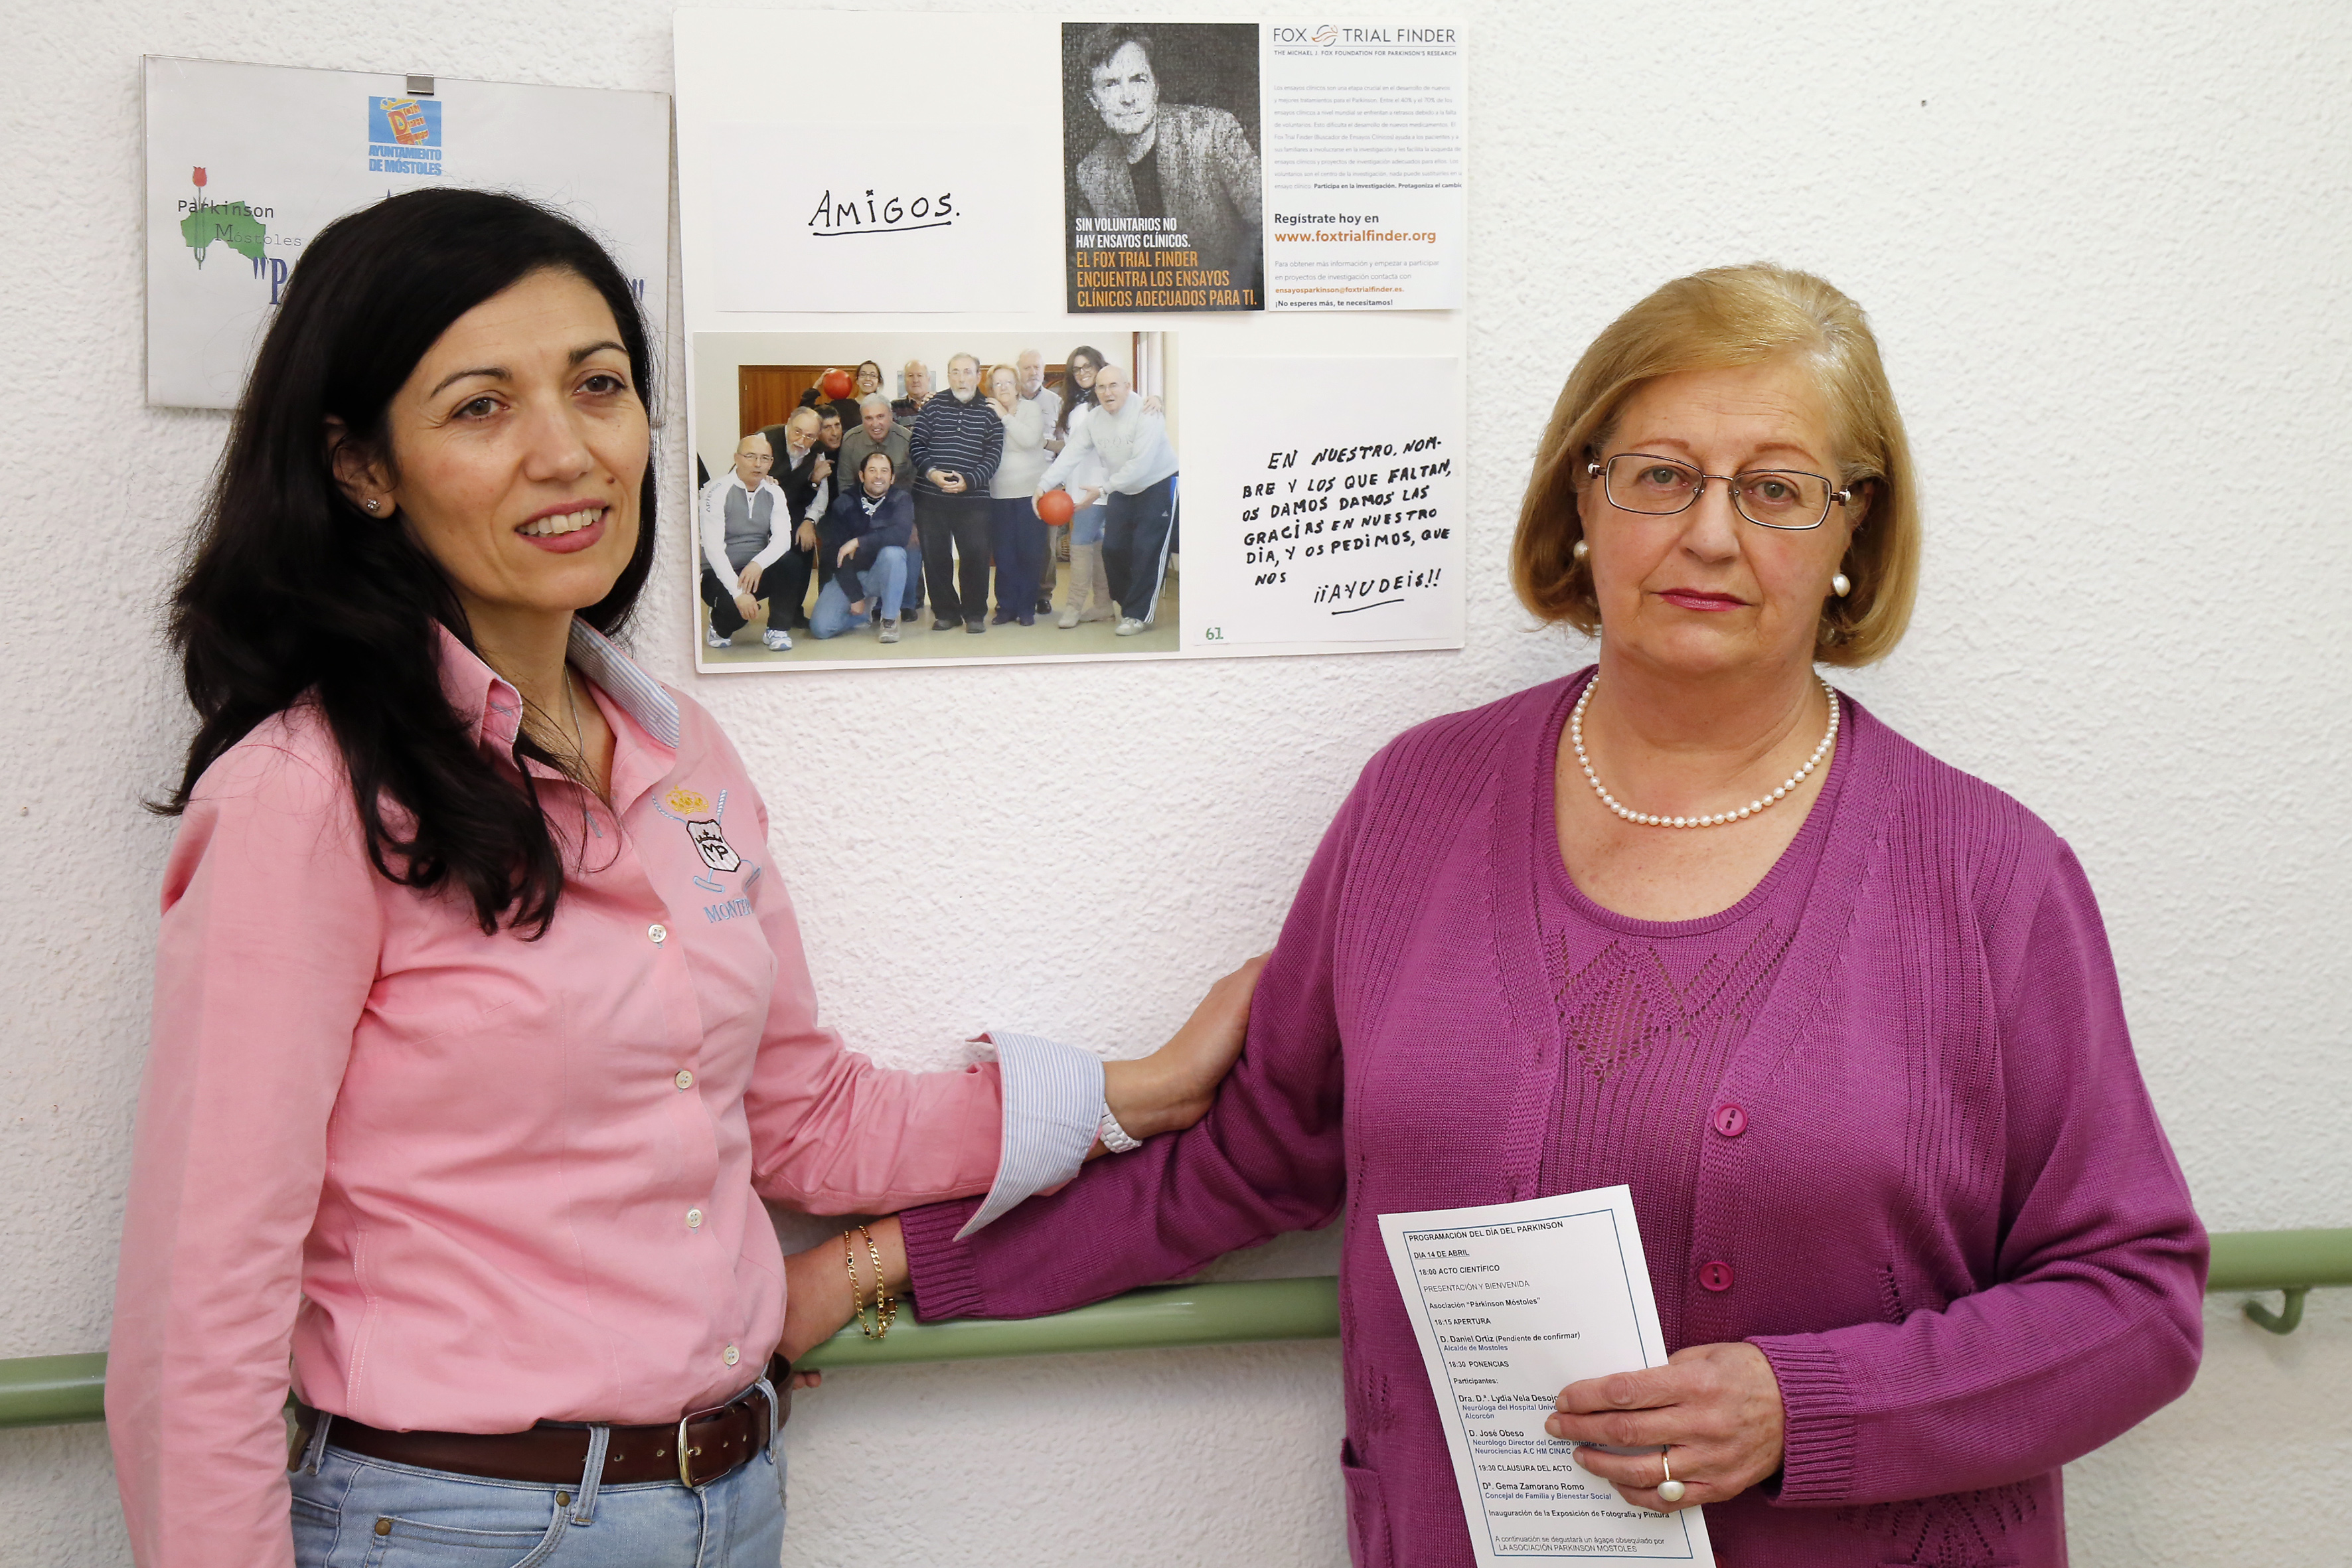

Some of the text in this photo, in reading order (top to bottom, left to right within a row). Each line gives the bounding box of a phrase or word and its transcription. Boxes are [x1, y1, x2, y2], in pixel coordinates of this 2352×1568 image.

[1273, 27, 1456, 43] FOX TRIAL FINDER
[368, 144, 442, 161] AYUNTAMIENTO
[368, 157, 442, 177] DE MÓSTOLES
[177, 200, 275, 218] Parkinson
[1075, 217, 1177, 232] SIN VOLUNTARIOS NO
[1275, 213, 1336, 226] Regístrate
[1339, 212, 1362, 226] hoy
[214, 223, 302, 247] Móstoles
[1075, 231, 1191, 248] HAY ENSAYOS CLÍNICOS.
[1274, 229, 1436, 244] www.foxtrialfinder.org
[1076, 250, 1198, 268] EL FOX TRIAL FINDER
[1077, 270, 1229, 289] ENCUENTRA LOS ENSAYOS
[1077, 287, 1257, 307] CLÍNICOS ADECUADOS PARA TI.
[1267, 449, 1299, 470] EN
[1242, 458, 1452, 499] BRE Y LOS QUE FALTAN,
[1241, 485, 1431, 522] OS DAMOS DAMOS LAS
[1330, 518, 1354, 532] EN
[1361, 508, 1438, 528] NUESTRO
[1285, 546, 1296, 561] Y
[1305, 544, 1325, 558] OS
[1421, 528, 1451, 542] QUE
[1254, 572, 1287, 586] NOS
[1205, 627, 1225, 641] 61
[1408, 1231, 1468, 1241] PROGRAMACIÓN
[1485, 1227, 1499, 1236] DÍA
[1516, 1221, 1563, 1233] PARKINSON
[1459, 1264, 1500, 1274] CIENTÍFICO
[1423, 1282, 1478, 1293] PRESENTACIÓN
[1484, 1280, 1530, 1290] BIENVENIDA
[1495, 1334, 1531, 1343] (Pendiente
[1543, 1331, 1580, 1340] confirmar)
[1490, 1394, 1512, 1403] Lydia
[1509, 1403, 1537, 1412] Hospital
[1479, 1429, 1498, 1437] José
[1472, 1439, 1507, 1447] Neurólogo
[1519, 1482, 1559, 1490] Zamorano
[1484, 1492, 1514, 1500] Concejal
[1551, 1510, 1590, 1518] Exposición
